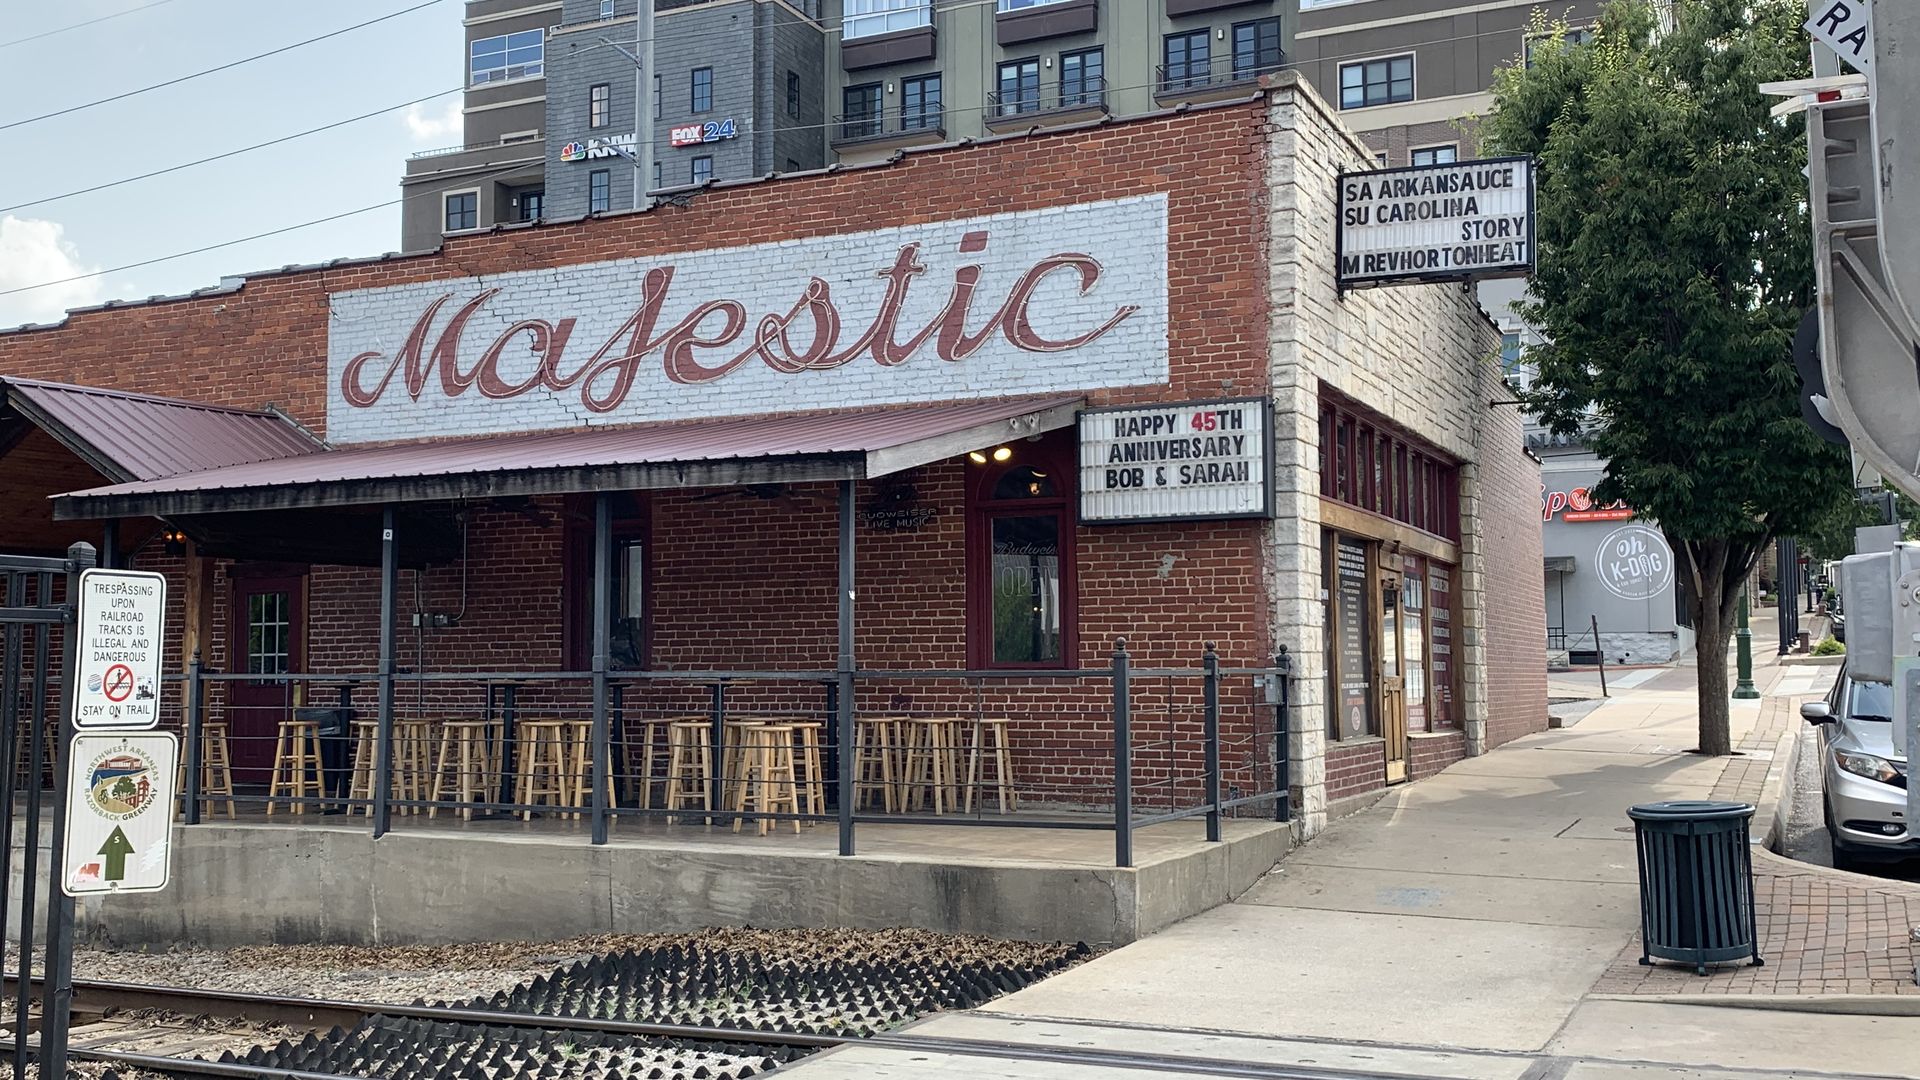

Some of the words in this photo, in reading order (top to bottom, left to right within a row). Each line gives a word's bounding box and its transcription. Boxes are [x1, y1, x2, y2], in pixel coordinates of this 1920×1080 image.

[1816, 0, 1866, 56] RA
[671, 125, 702, 145] FOX
[703, 118, 735, 142] 24
[1346, 182, 1373, 202] SA
[1378, 168, 1513, 199] ARKANSAUCE
[1344, 206, 1369, 226] SU
[1376, 197, 1479, 223] CAROLINA
[1461, 217, 1525, 241] STORY
[341, 230, 1142, 413] Majestic
[1114, 414, 1176, 437] HAPPY
[1191, 409, 1242, 431] 45TH
[1108, 435, 1245, 463] ANNIVERSARY
[1106, 468, 1144, 489] BOB
[1155, 466, 1167, 486] &
[1180, 461, 1249, 485] SARAH
[865, 519, 890, 529] LIVE
[896, 516, 929, 527] MUSIC
[997, 541, 1058, 556] Budweis
[1616, 536, 1647, 558] Oh
[1610, 552, 1662, 582] K-DOG
[94, 584, 153, 596] TRESPASSING
[1002, 565, 1056, 597] OPEN
[100, 611, 144, 622] RAILROAD
[111, 598, 135, 608] UPON
[99, 624, 132, 635] TRACKS
[136, 626, 145, 635] IS
[92, 638, 127, 649] ILLEGAL
[131, 639, 149, 649] AND
[93, 652, 146, 662] DANGEROUS
[83, 705, 105, 716] STAY
[109, 705, 121, 716] ON
[126, 705, 150, 715] TRAIL
[85, 745, 128, 780] NORTHWEST
[129, 746, 159, 781] ARKANSAS
[85, 787, 120, 821] RAZORBACK
[122, 787, 158, 821] GREENWAY
